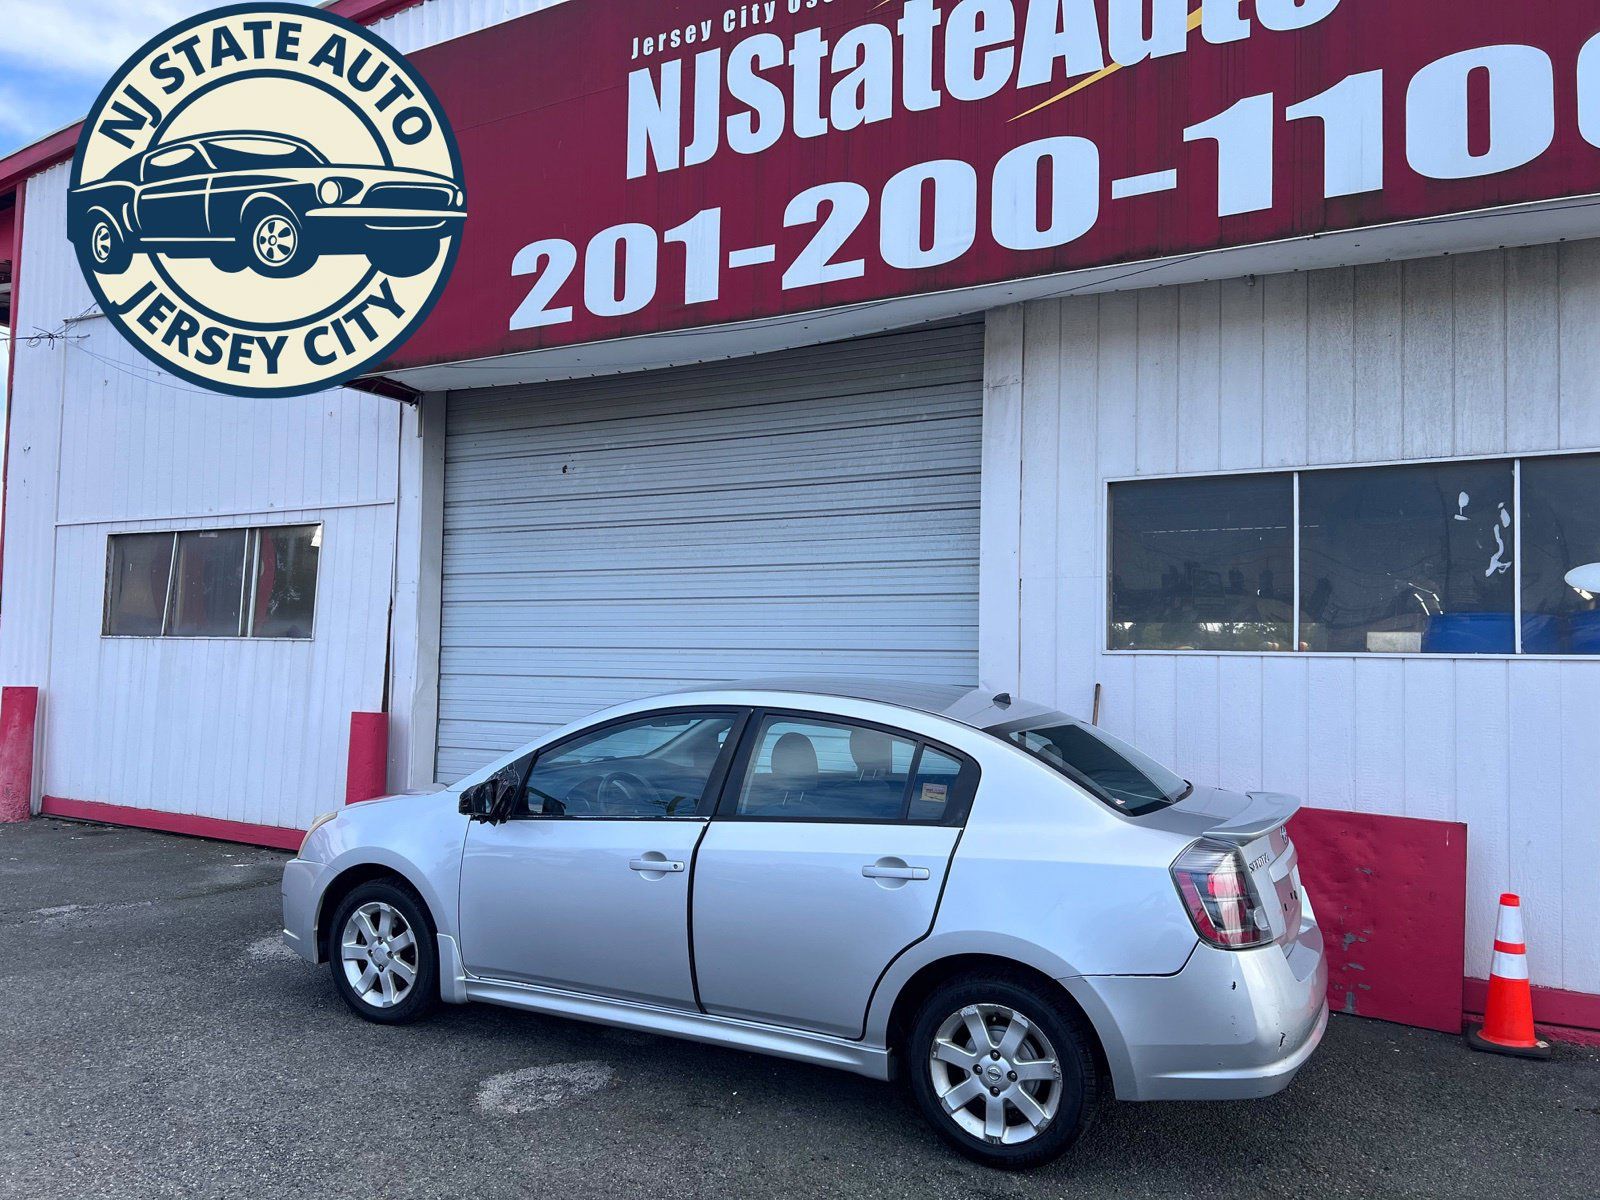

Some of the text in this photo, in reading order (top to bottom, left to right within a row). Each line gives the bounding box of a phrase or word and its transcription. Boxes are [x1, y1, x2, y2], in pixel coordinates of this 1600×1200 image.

[631, 1, 776, 60] Jersey City
[509, 31, 1600, 331] 201-200-110
